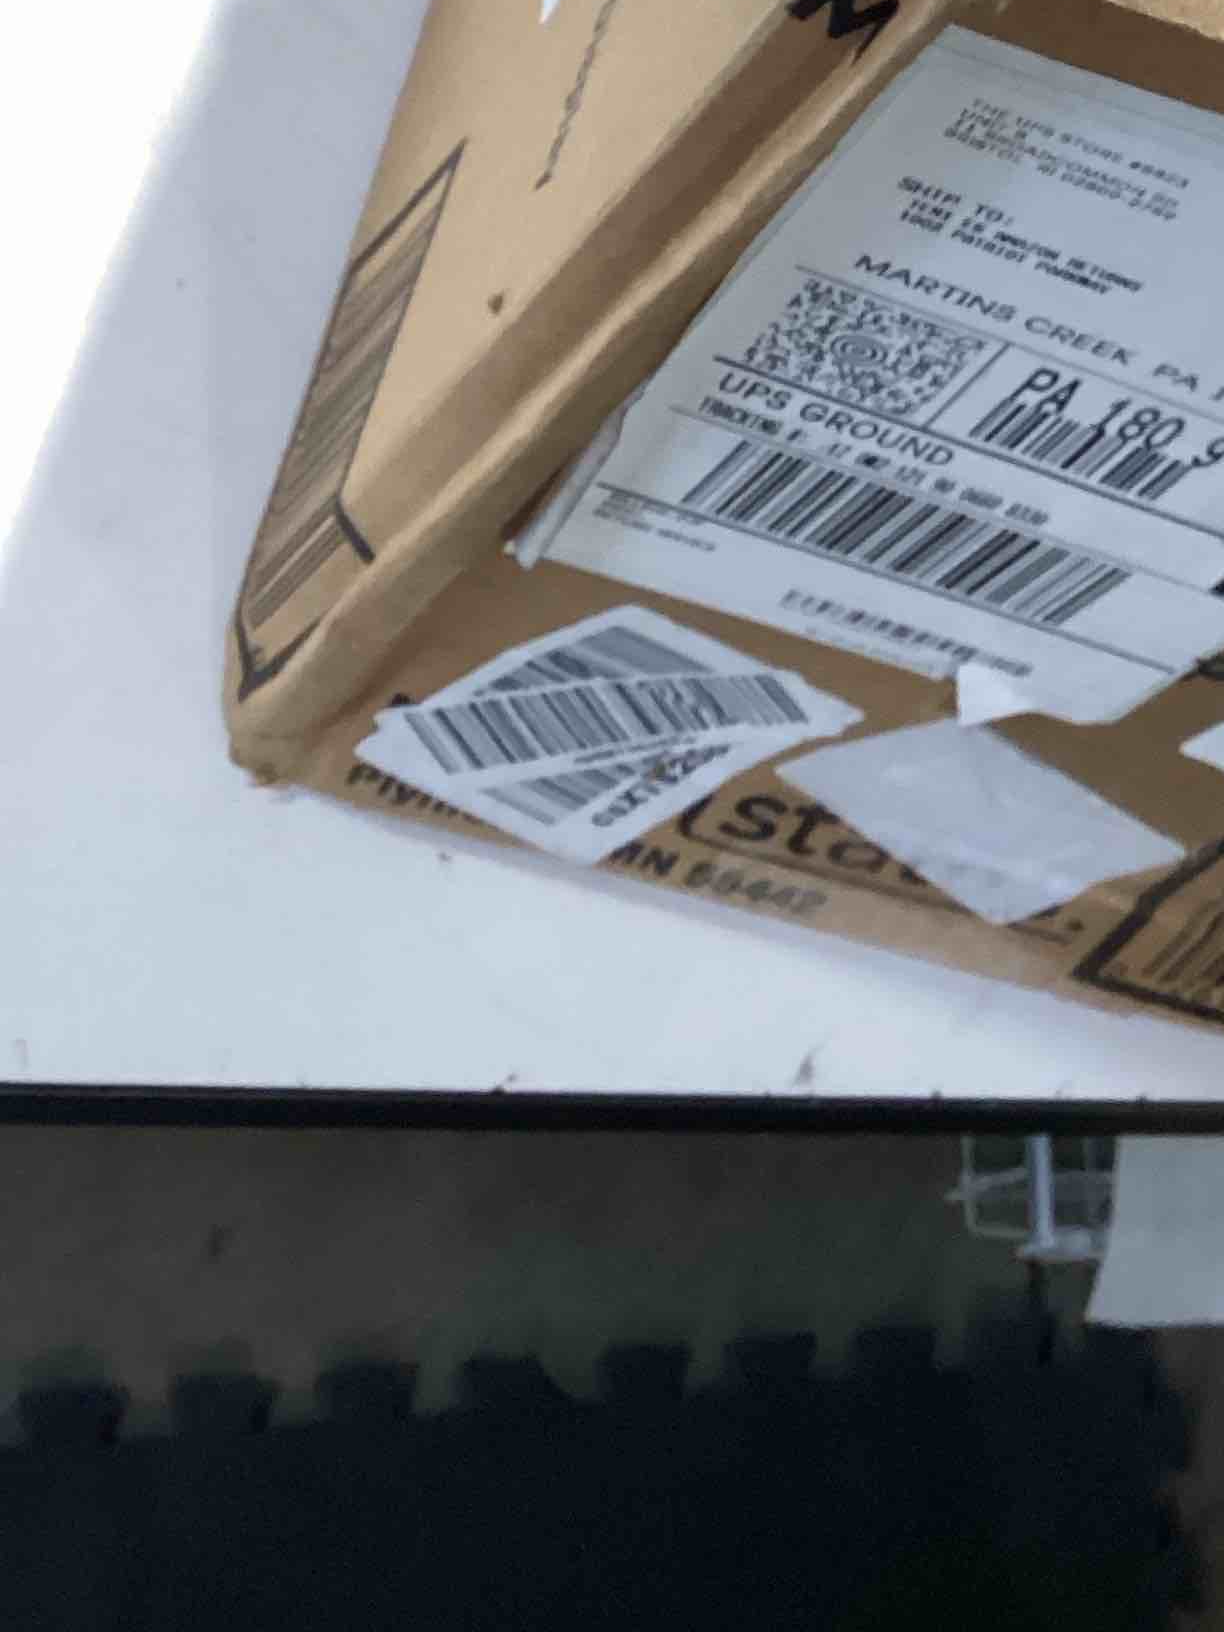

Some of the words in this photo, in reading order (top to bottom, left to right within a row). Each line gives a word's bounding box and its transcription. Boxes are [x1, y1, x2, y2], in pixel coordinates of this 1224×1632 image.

[853, 251, 1018, 325] MARTINS
[1024, 314, 1132, 367] CREEK
[1150, 362, 1202, 394] PA
[717, 370, 793, 411] UPS
[798, 401, 956, 467] GROUND
[1011, 367, 1087, 424] PA
[1087, 394, 1186, 453] 180
